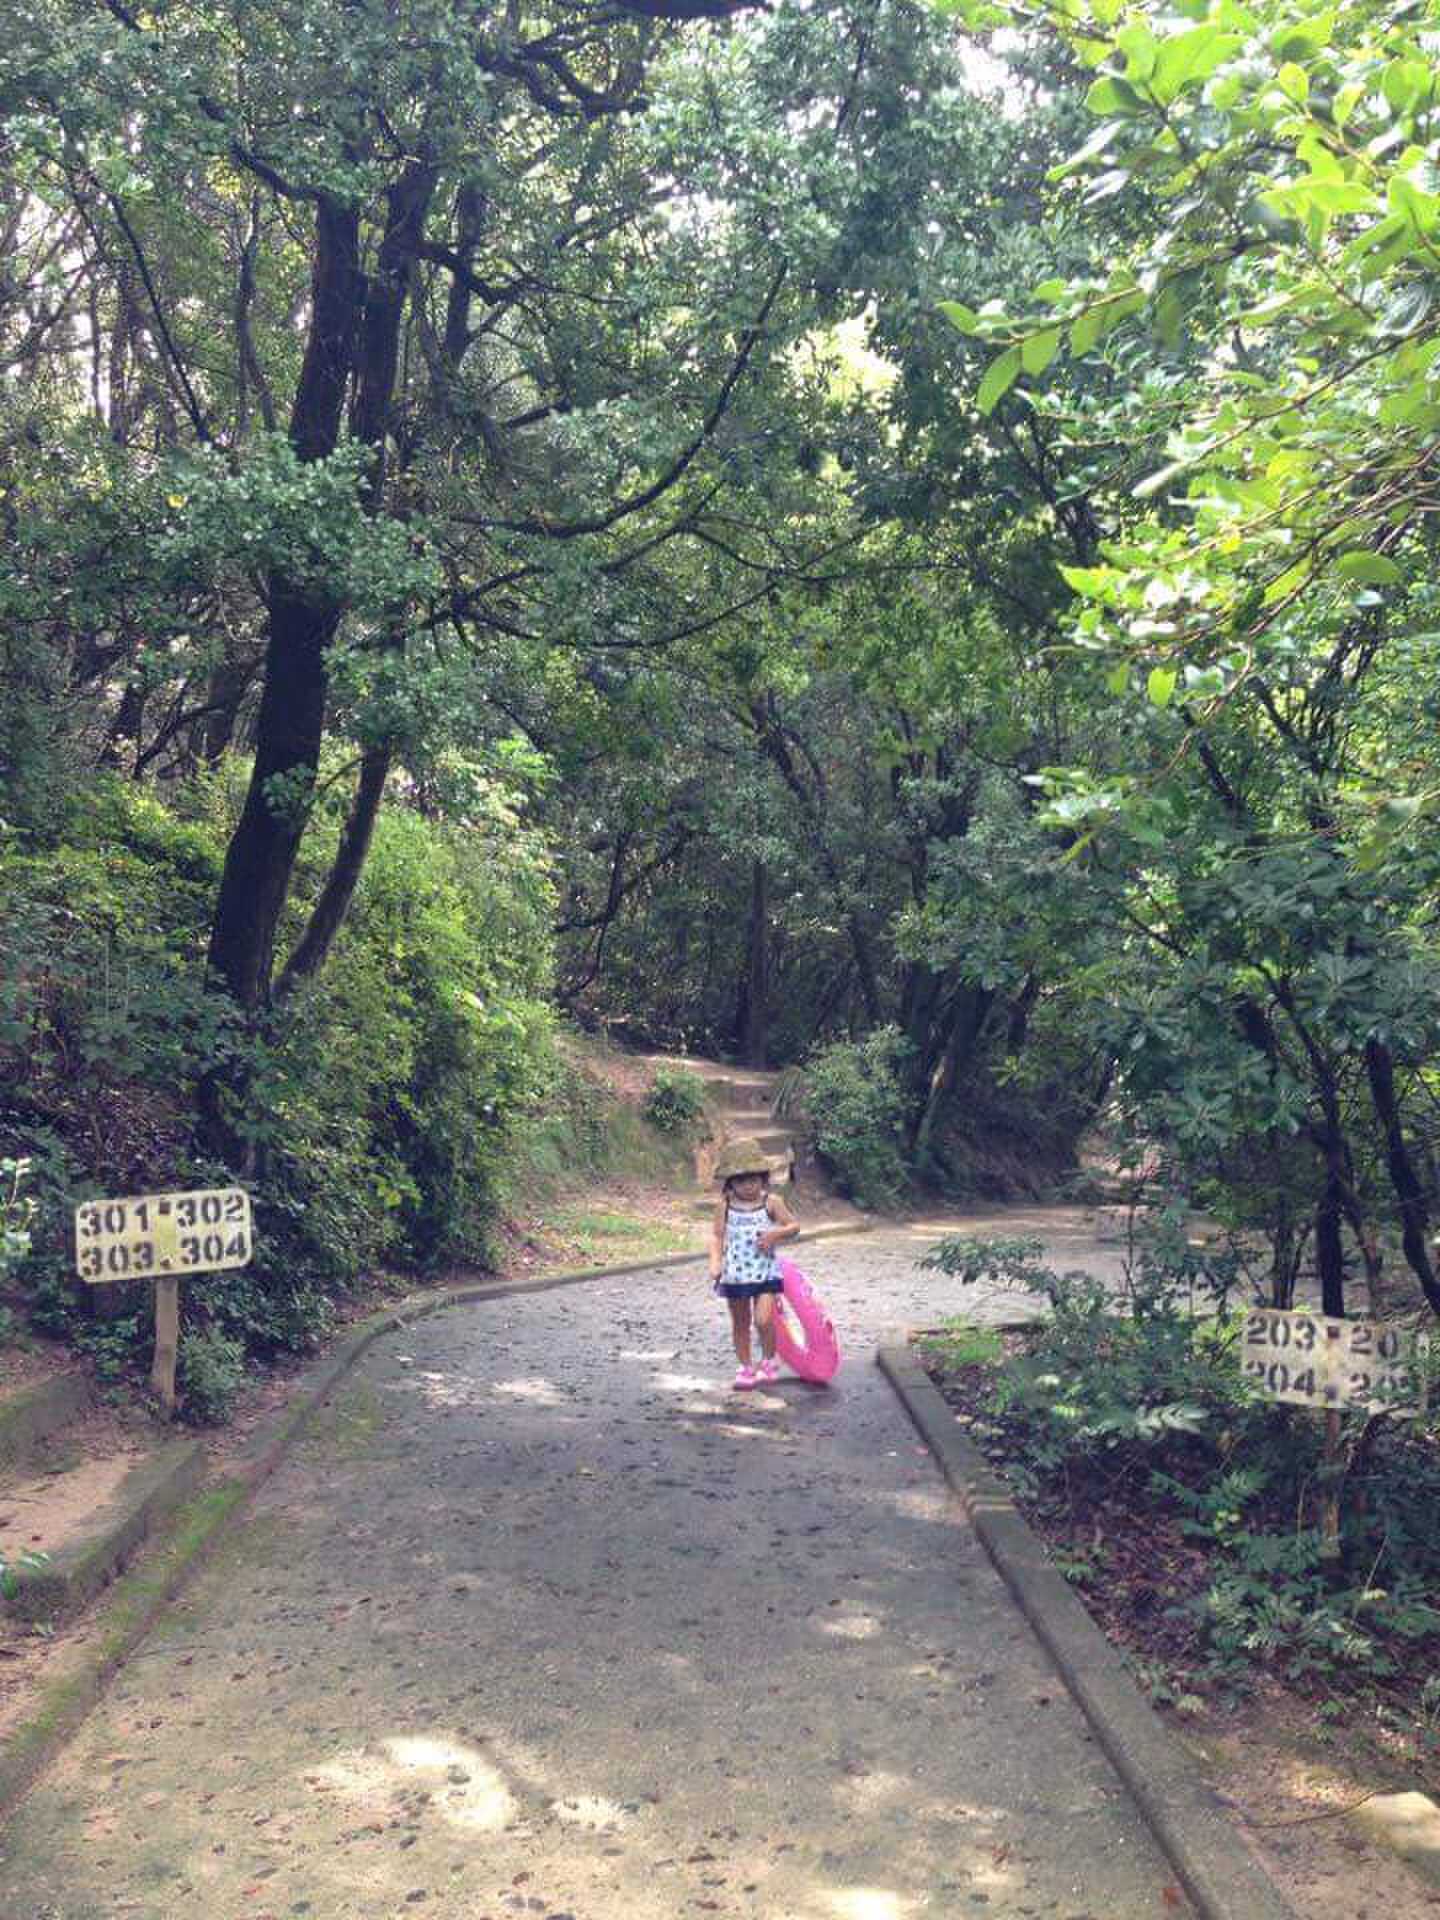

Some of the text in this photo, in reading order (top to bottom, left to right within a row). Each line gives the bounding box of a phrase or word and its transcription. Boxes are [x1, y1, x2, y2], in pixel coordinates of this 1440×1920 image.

[79, 1194, 245, 1237] 301 302
[80, 1231, 246, 1276] 303 304
[1247, 1315, 1316, 1350] 203
